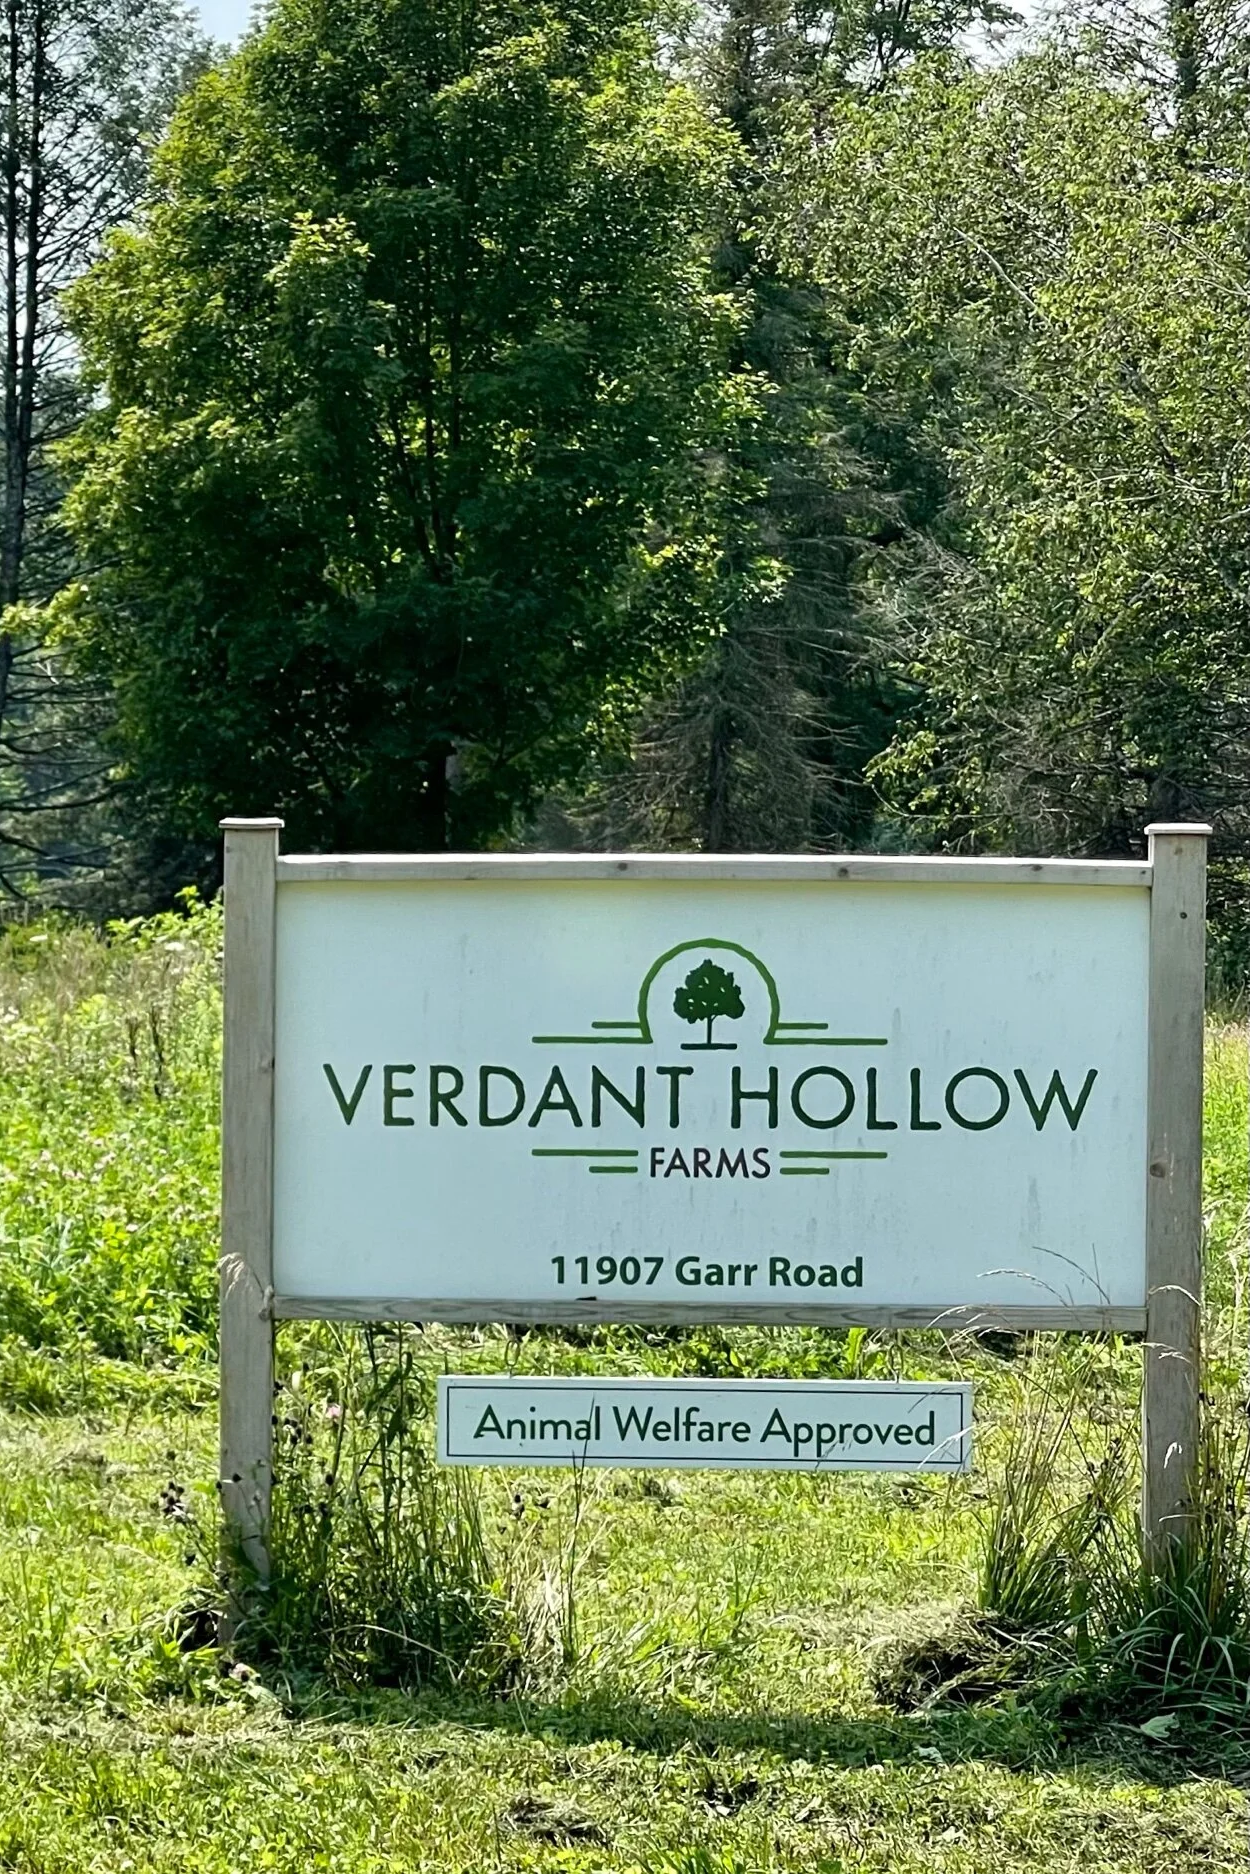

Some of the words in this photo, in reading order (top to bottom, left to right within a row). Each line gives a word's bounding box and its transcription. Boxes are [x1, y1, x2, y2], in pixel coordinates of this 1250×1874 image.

[323, 1063, 694, 1129] VERDANT
[730, 1066, 1098, 1132] HOLLOW
[649, 1147, 771, 1179] FARMS
[551, 1256, 663, 1286] 11907
[675, 1256, 757, 1287] Garr
[769, 1256, 863, 1287] Road
[473, 1404, 601, 1441] Animal
[613, 1406, 751, 1442] Welfare
[760, 1408, 935, 1456] Approved
